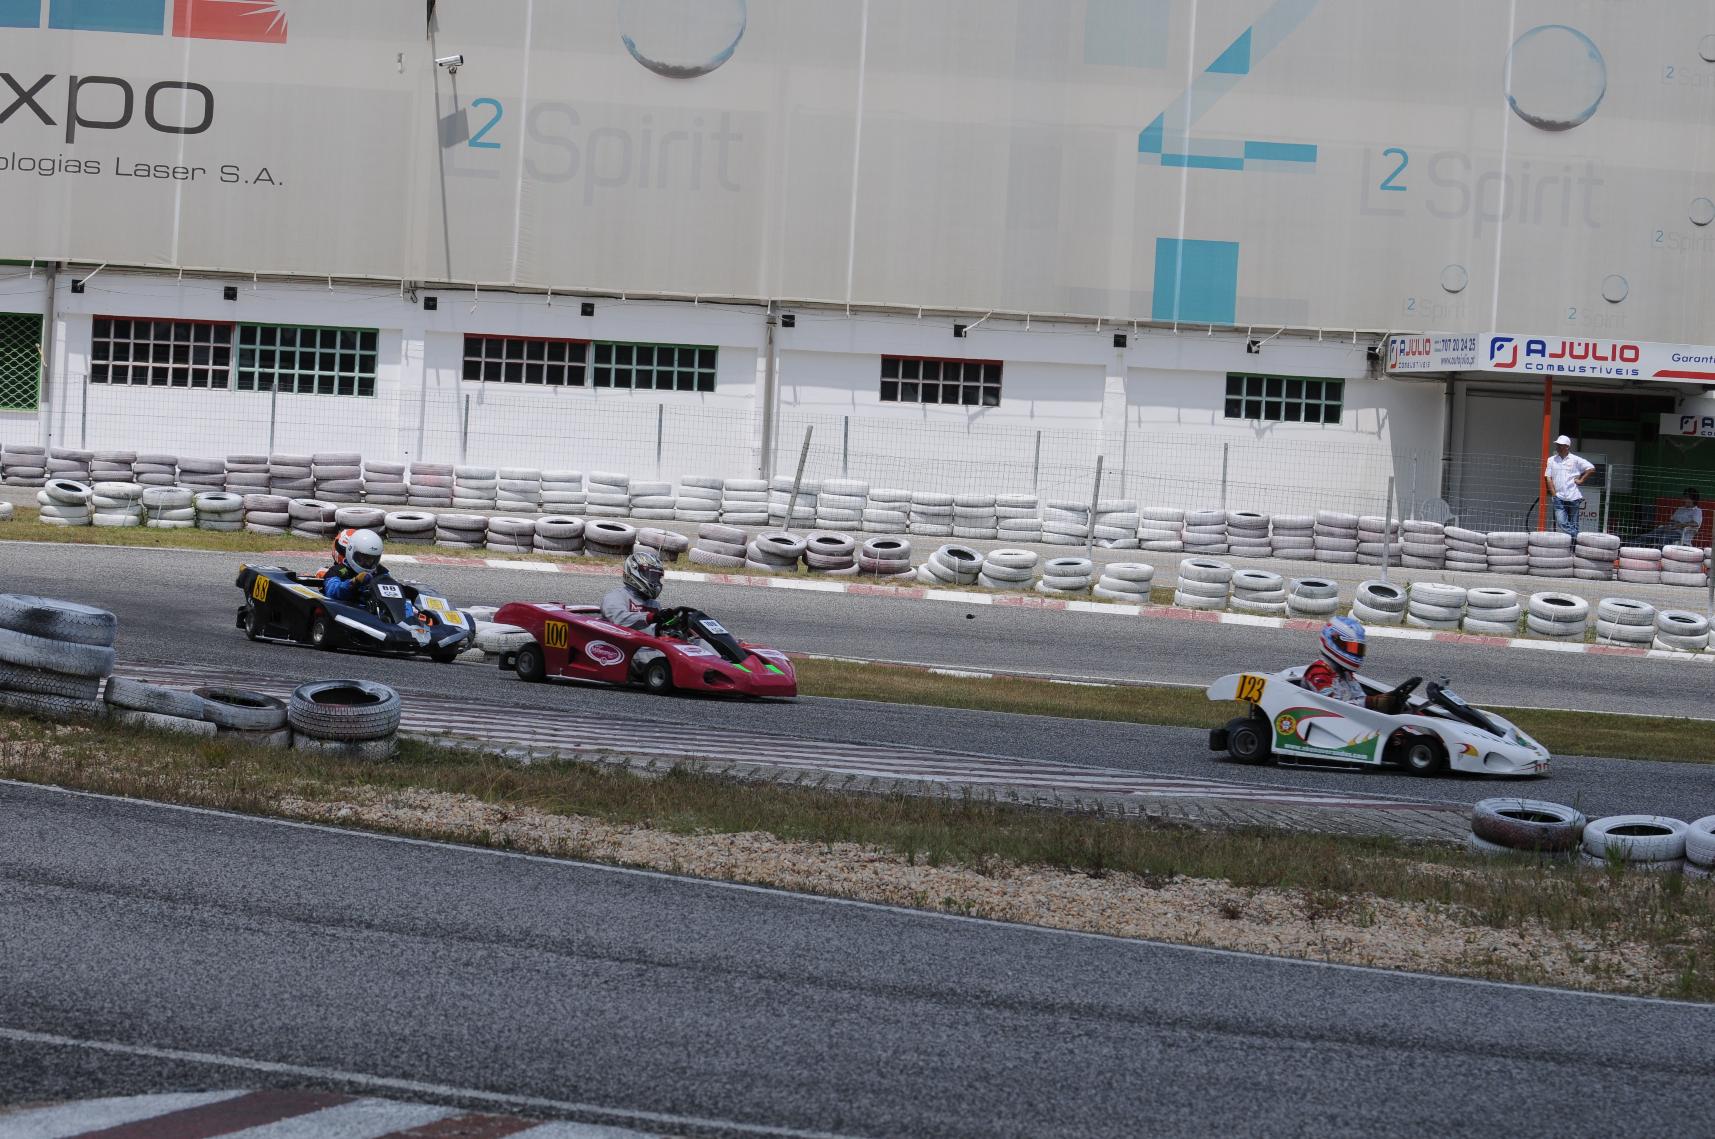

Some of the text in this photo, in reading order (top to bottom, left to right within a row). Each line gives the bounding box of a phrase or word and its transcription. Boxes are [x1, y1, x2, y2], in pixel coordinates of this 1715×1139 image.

[524, 101, 743, 206] Spirit
[115, 156, 207, 181] Laser
[220, 164, 284, 186] S.A.
[1425, 151, 1606, 239] Spirit
[546, 622, 567, 647] 100
[1235, 675, 1265, 703] 123
